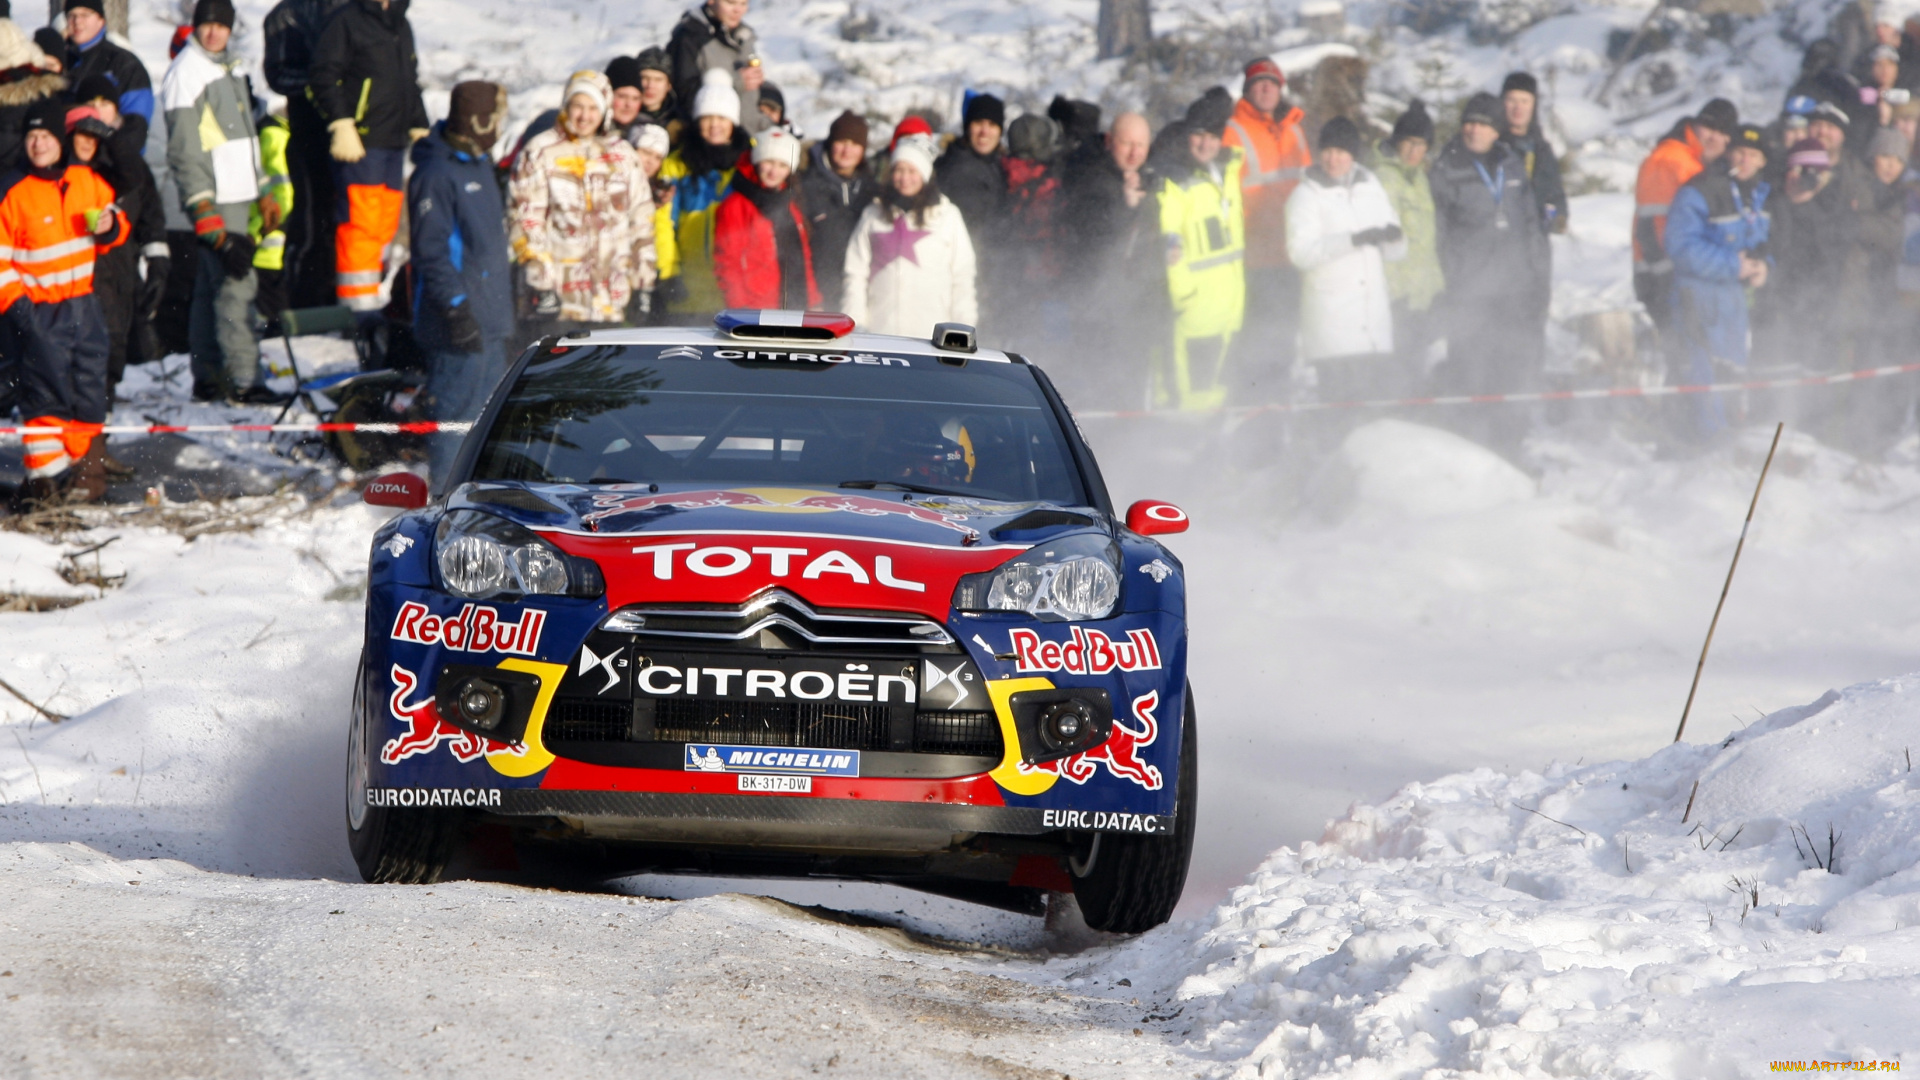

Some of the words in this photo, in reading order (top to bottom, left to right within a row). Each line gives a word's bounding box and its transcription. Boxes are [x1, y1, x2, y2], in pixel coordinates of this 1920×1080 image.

[370, 483, 410, 494] TOTAL
[632, 543, 925, 592] TOTAL
[728, 751, 851, 769] MICHELIN
[742, 776, 807, 790] BK-317-DW
[366, 788, 501, 806] EURODATACAR
